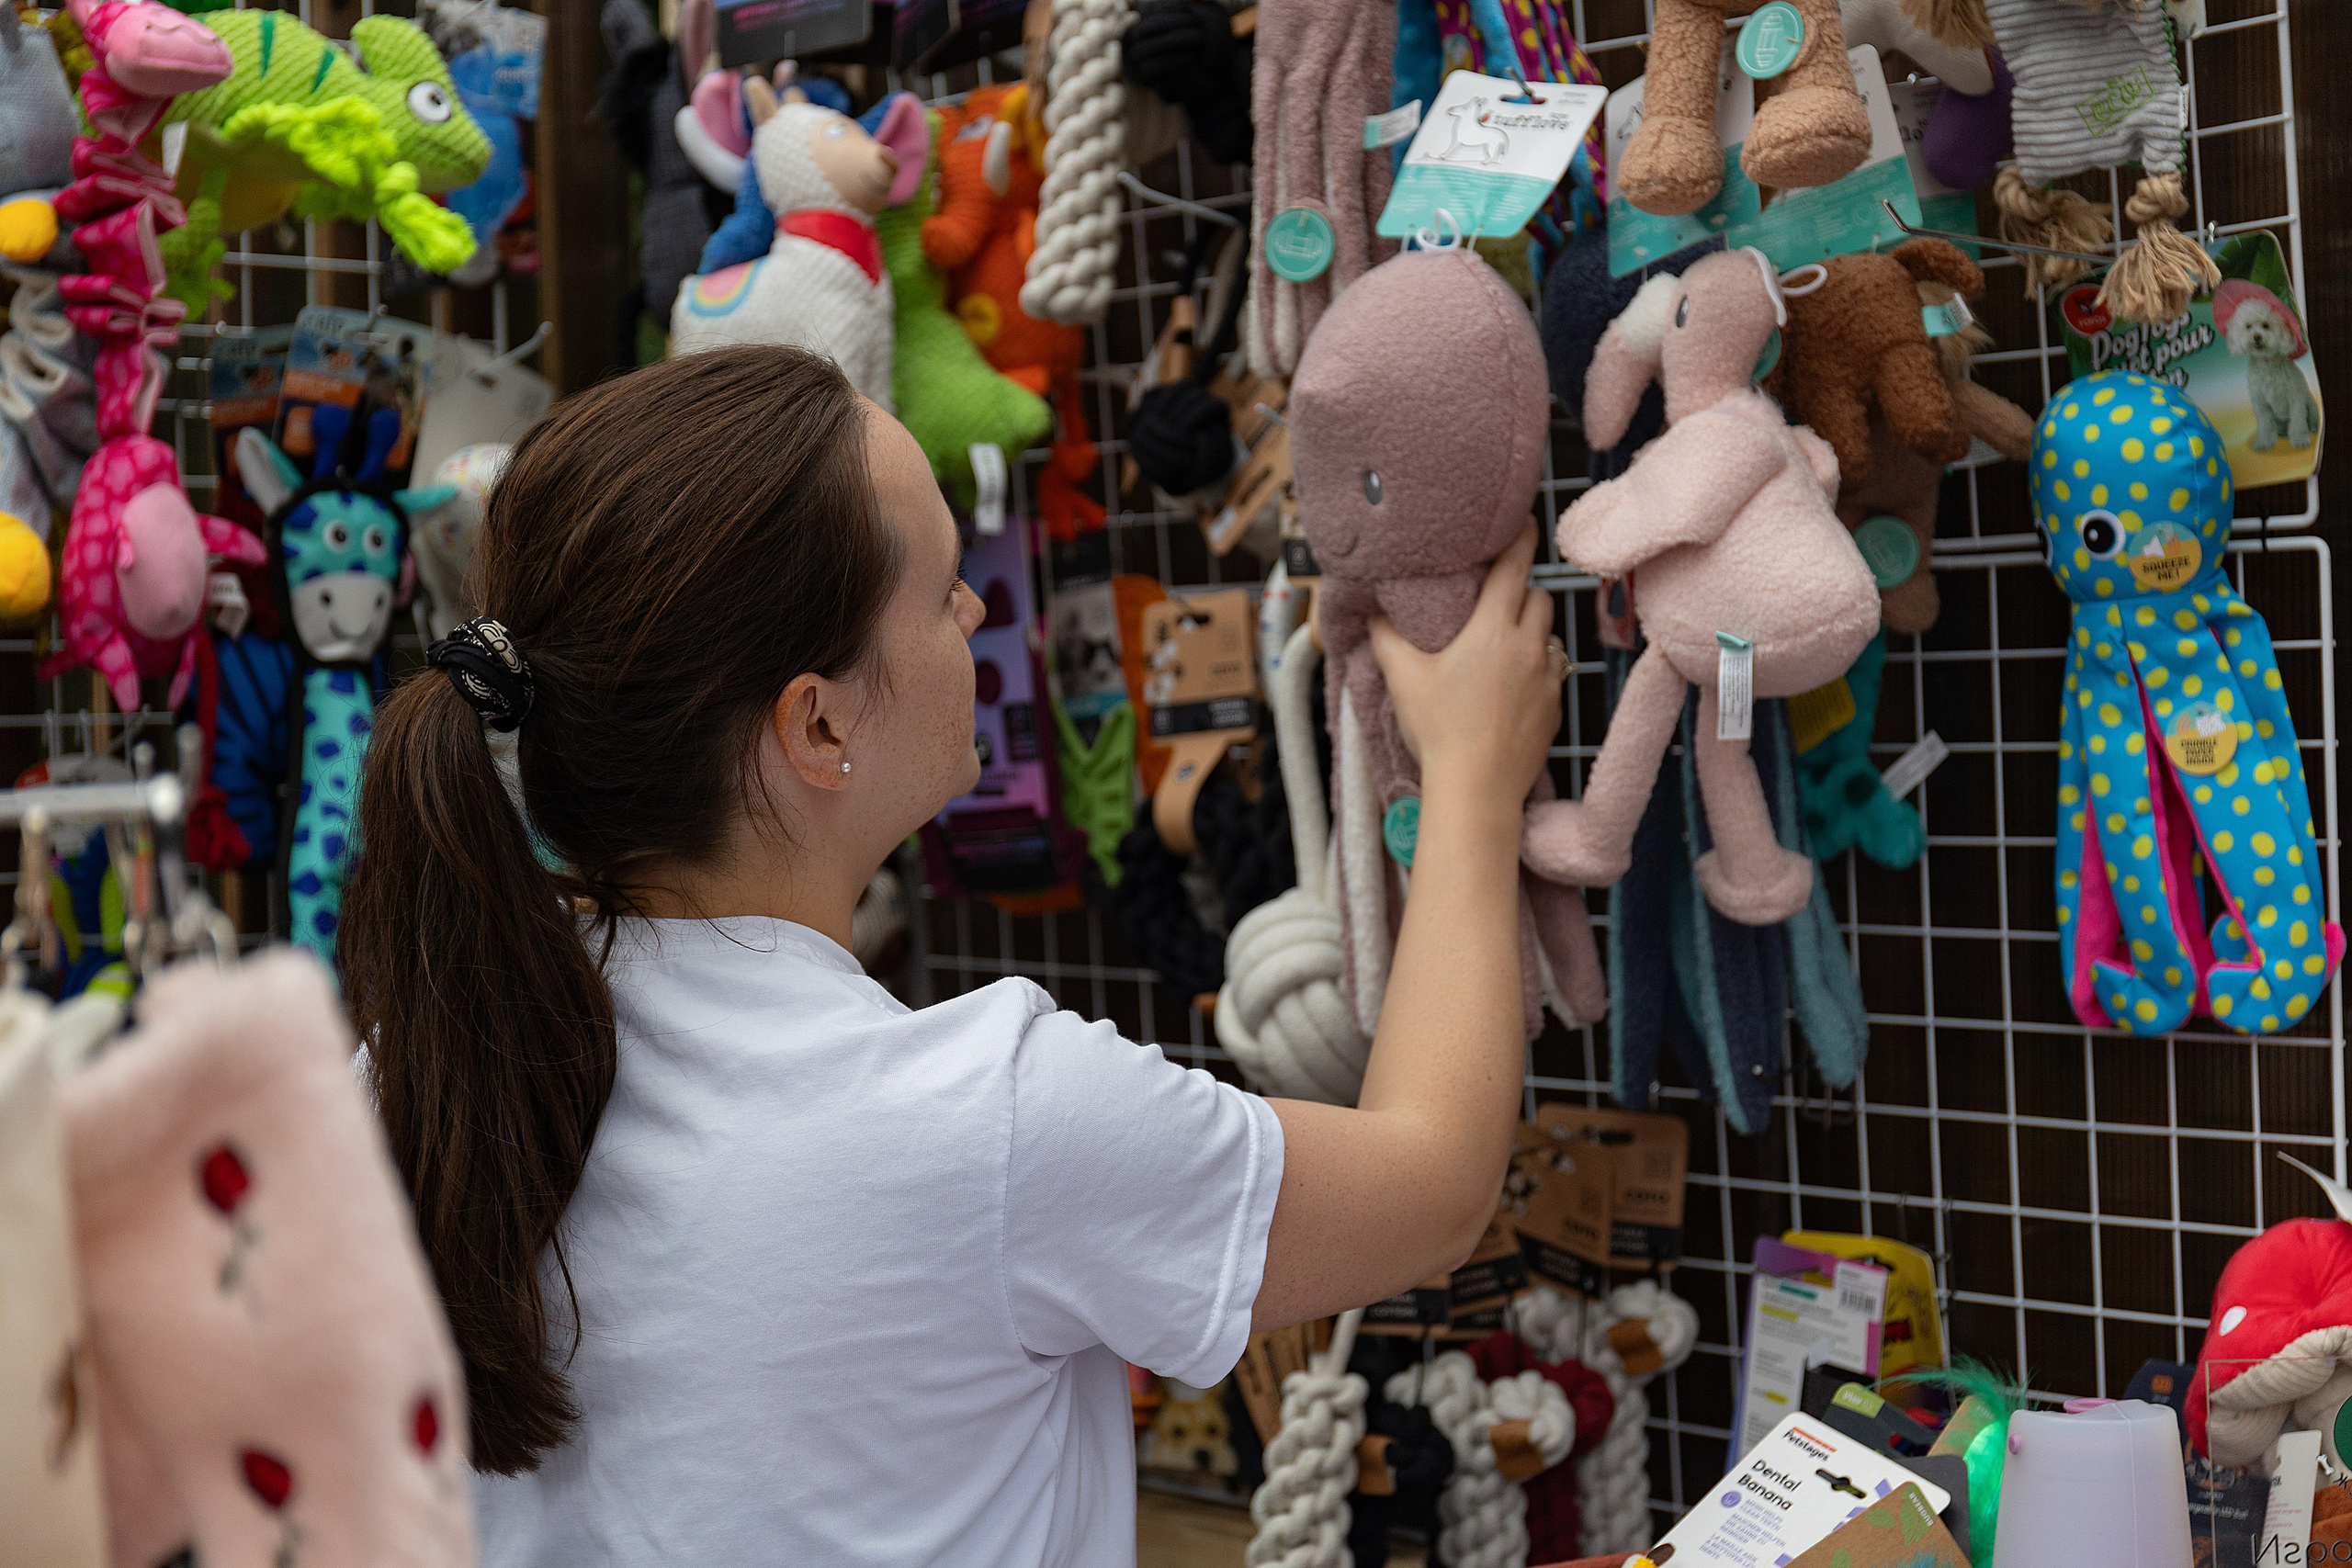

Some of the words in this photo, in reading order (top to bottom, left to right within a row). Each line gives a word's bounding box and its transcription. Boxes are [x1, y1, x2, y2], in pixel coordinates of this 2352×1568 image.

[2089, 326, 2141, 372] Dog
[2155, 323, 2214, 375] pour
[1782, 1428, 1831, 1461] Petstages
[1738, 1473, 1794, 1511] Banana
[1752, 1459, 1803, 1493] Dental
